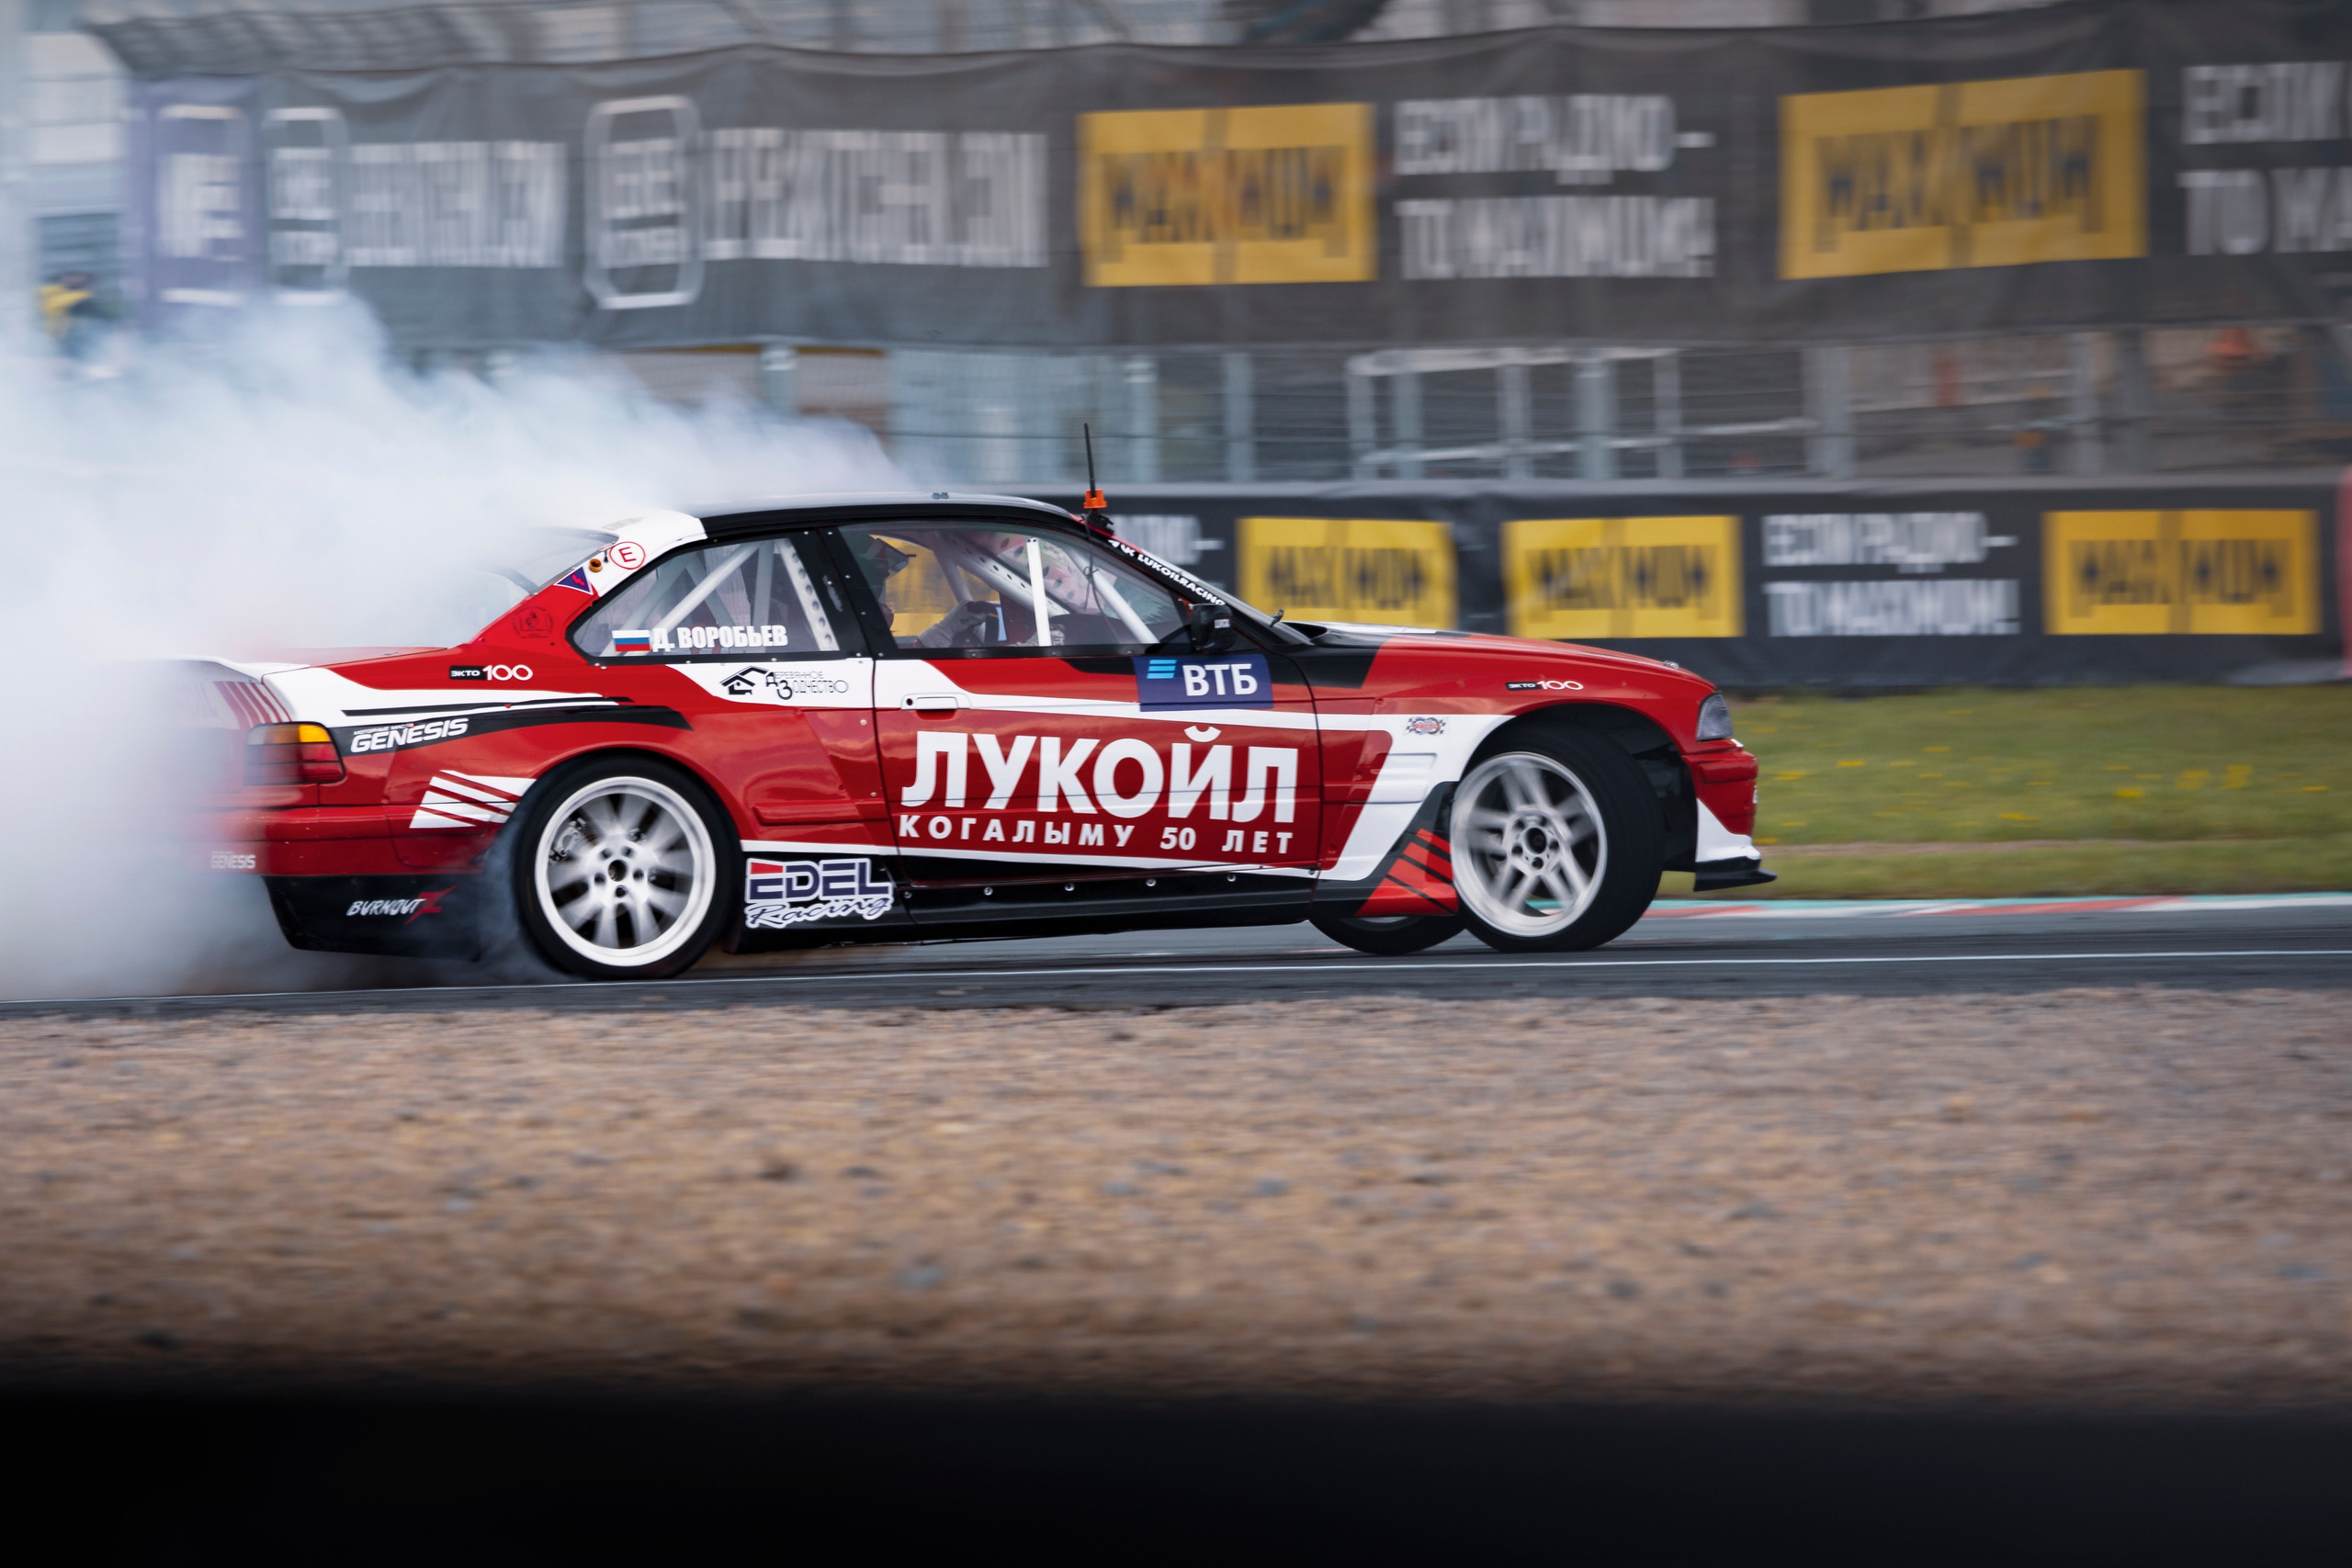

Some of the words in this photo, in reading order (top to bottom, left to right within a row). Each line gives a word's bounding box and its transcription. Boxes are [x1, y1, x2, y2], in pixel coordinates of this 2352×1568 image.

[677, 625, 788, 649] ВОРОБЬЕВ
[482, 664, 533, 681] 100
[1182, 663, 1258, 697] ВТБ
[1537, 681, 1584, 690] 100
[351, 718, 469, 753] GENESIS
[901, 726, 1298, 823] ЛУКОЙЛ
[899, 815, 1136, 847] КОГАЛЫМУ
[1159, 827, 1195, 851] 50
[1222, 829, 1294, 854] ЛЕТ
[747, 860, 892, 901] EDEL
[747, 897, 892, 925] Racing
